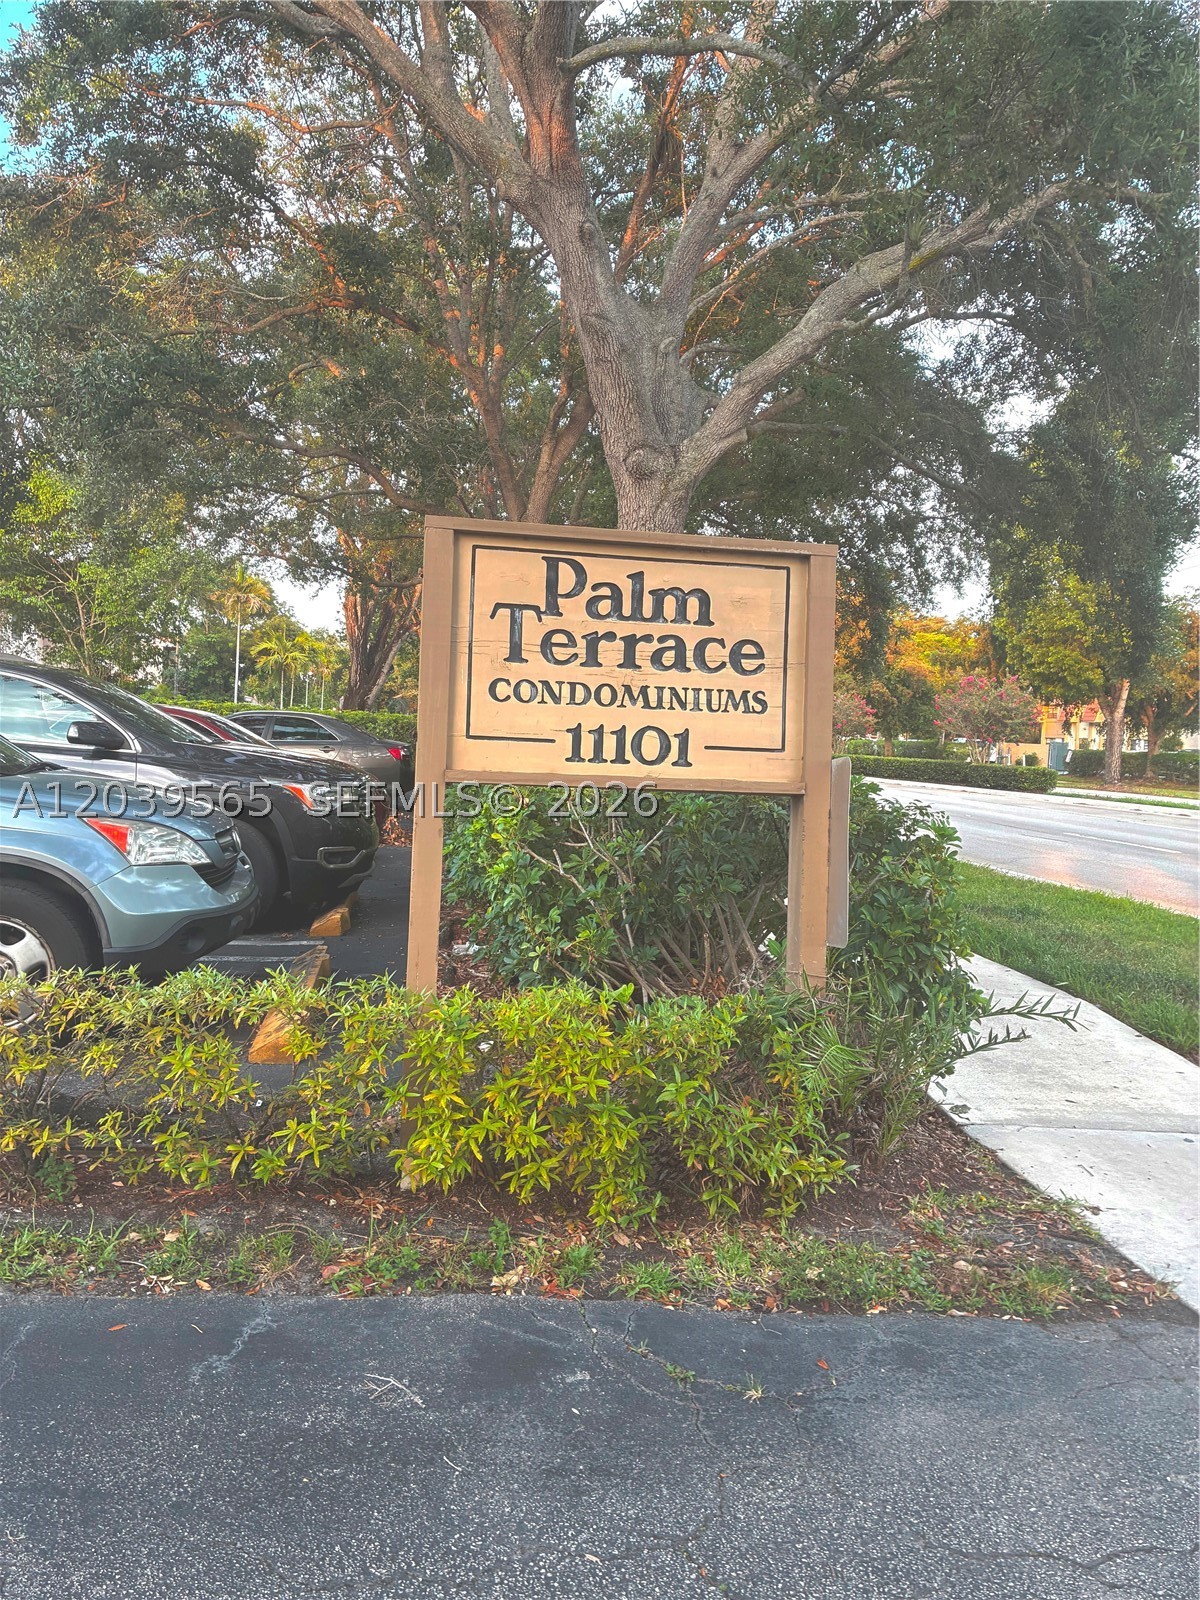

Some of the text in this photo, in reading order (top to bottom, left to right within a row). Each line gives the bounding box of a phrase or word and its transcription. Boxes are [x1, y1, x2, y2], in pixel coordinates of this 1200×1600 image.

[541, 555, 715, 627] Palm
[489, 602, 766, 676] Terrace
[488, 677, 769, 714] CONDOMINIUMS
[565, 722, 693, 768] 11101
